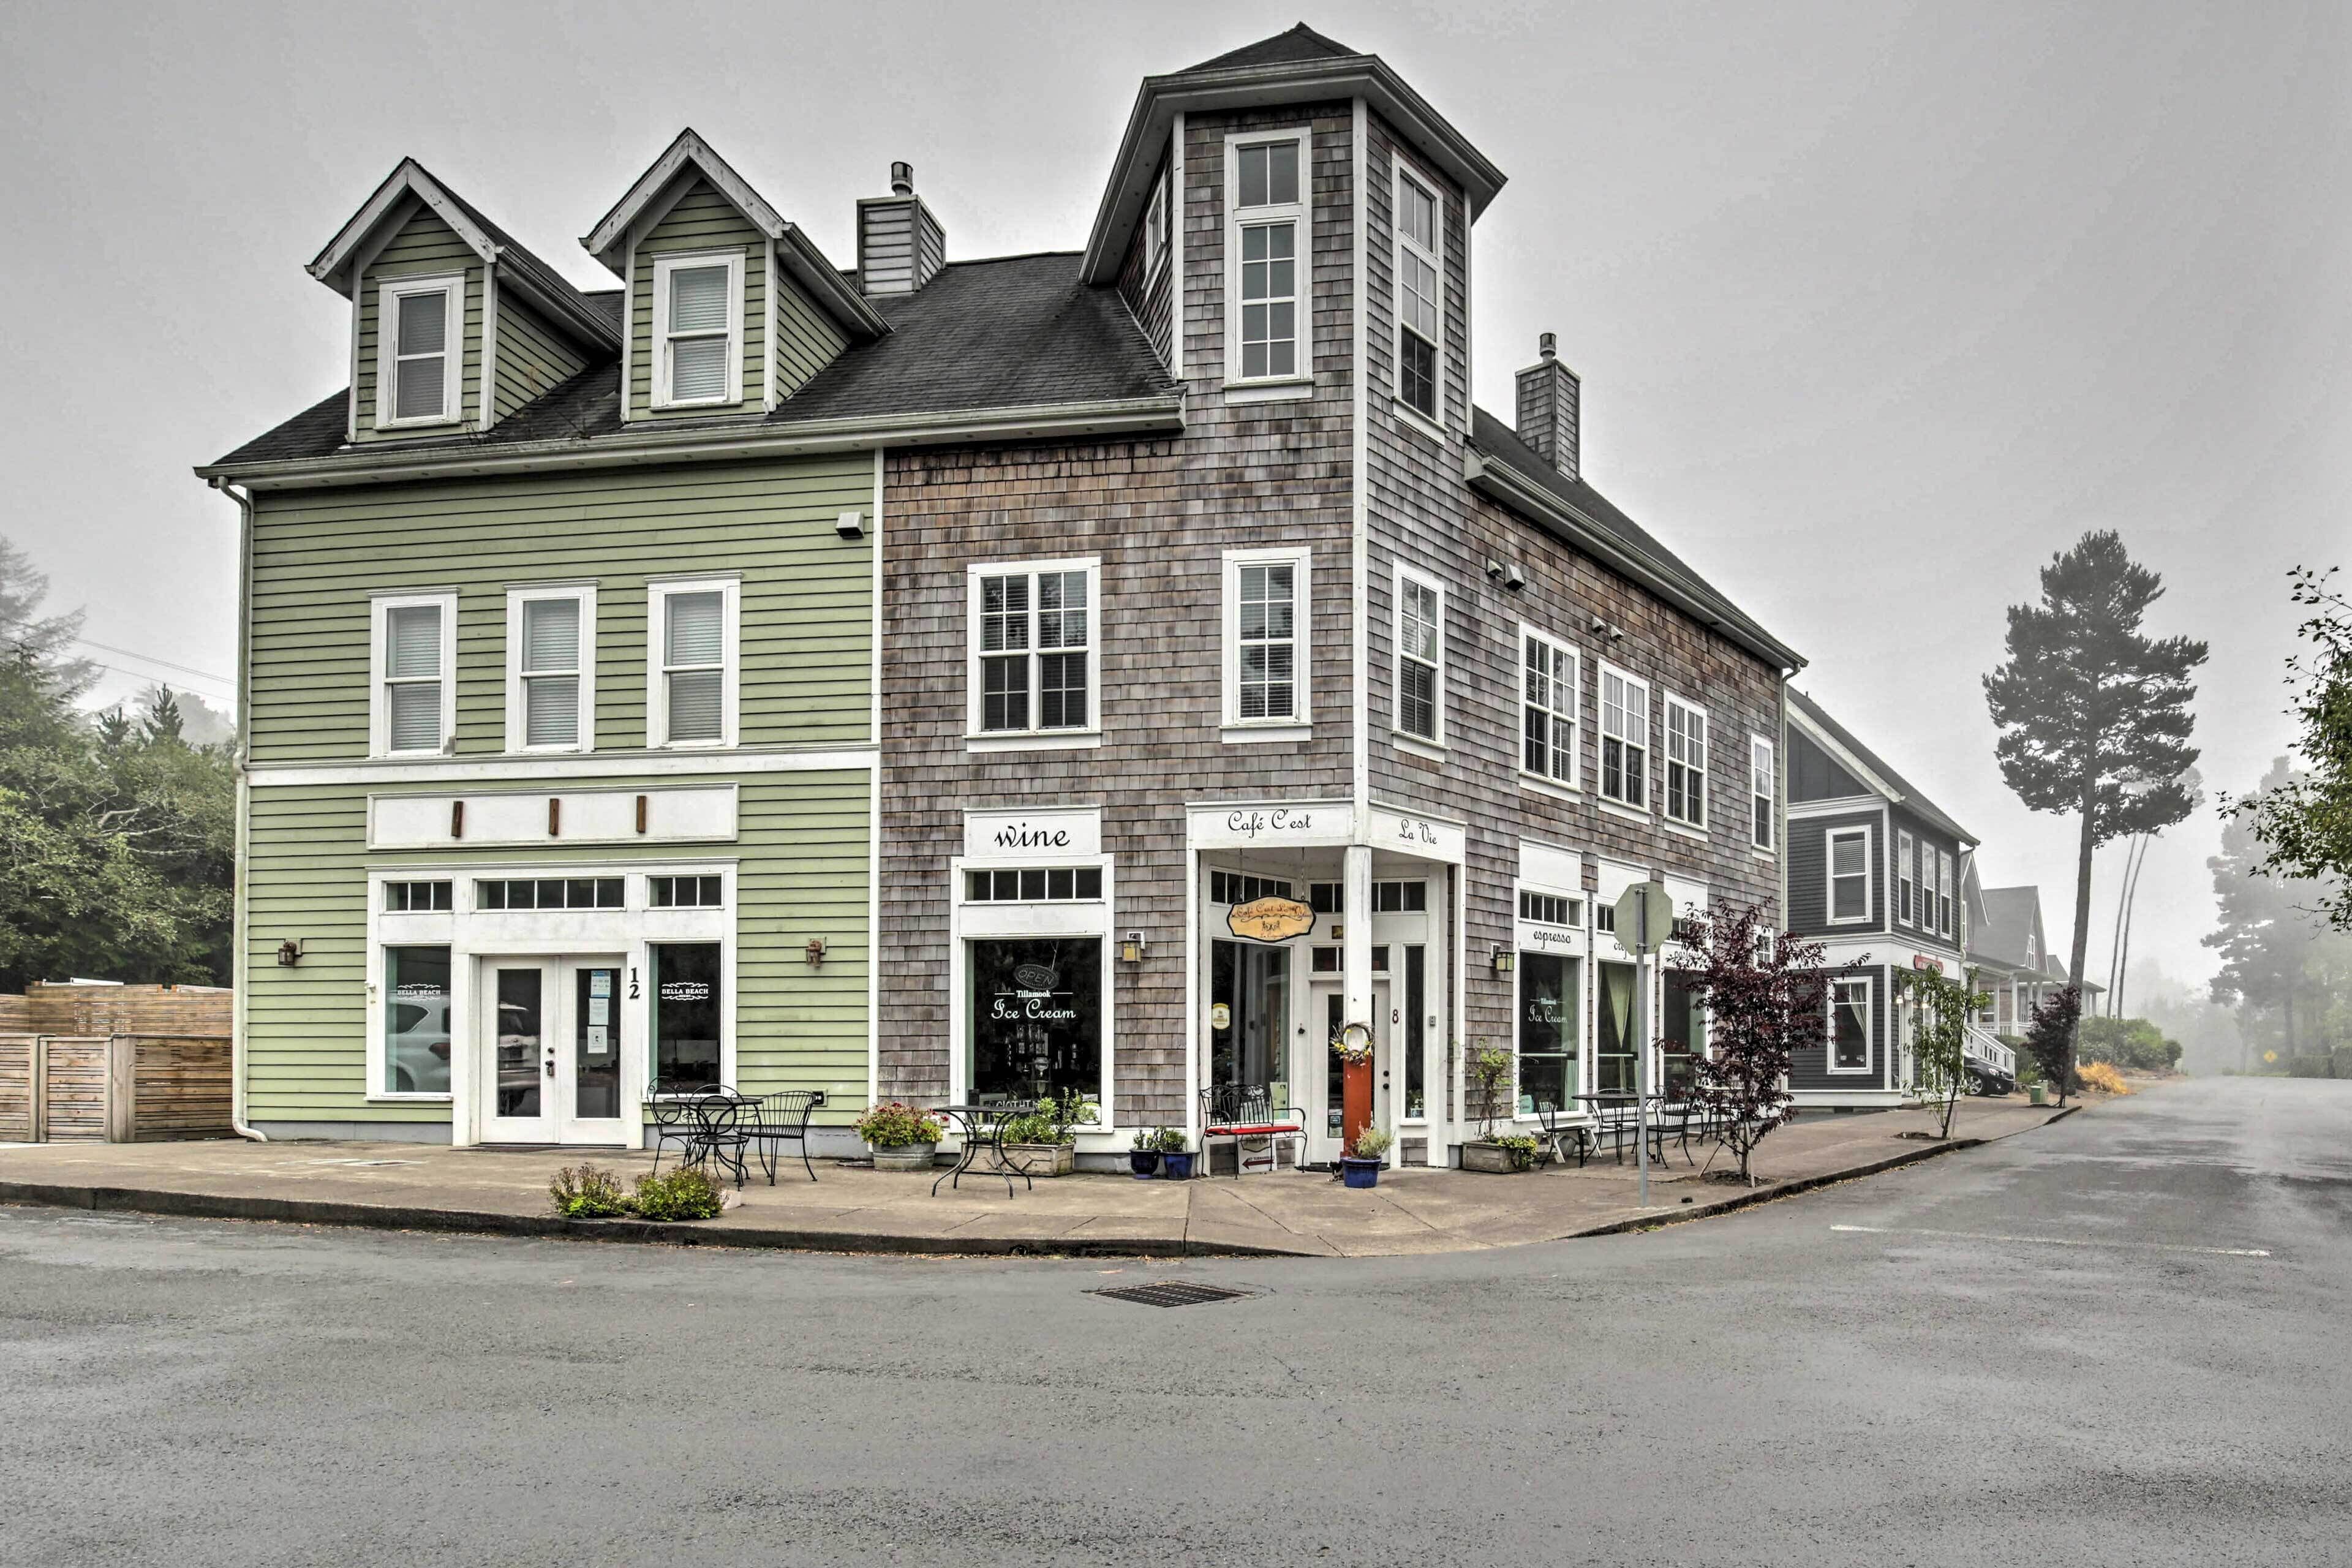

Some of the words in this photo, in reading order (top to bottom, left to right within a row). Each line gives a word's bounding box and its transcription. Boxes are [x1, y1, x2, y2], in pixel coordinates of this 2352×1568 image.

[1228, 810, 1264, 839] Café
[1272, 809, 1311, 829] C'est
[1399, 819, 1414, 840] La
[1419, 823, 1438, 844] Vie
[994, 822, 1070, 848] wine
[1534, 931, 1571, 950] espresso
[1019, 970, 1054, 985] OPEN
[1016, 989, 1051, 998] Tillamook
[991, 998, 1020, 1019] Ice
[1026, 998, 1076, 1019] Cream
[1392, 1009, 1398, 1023] 8
[1528, 1005, 1542, 1022] Ice
[1545, 1005, 1568, 1023] Cream
